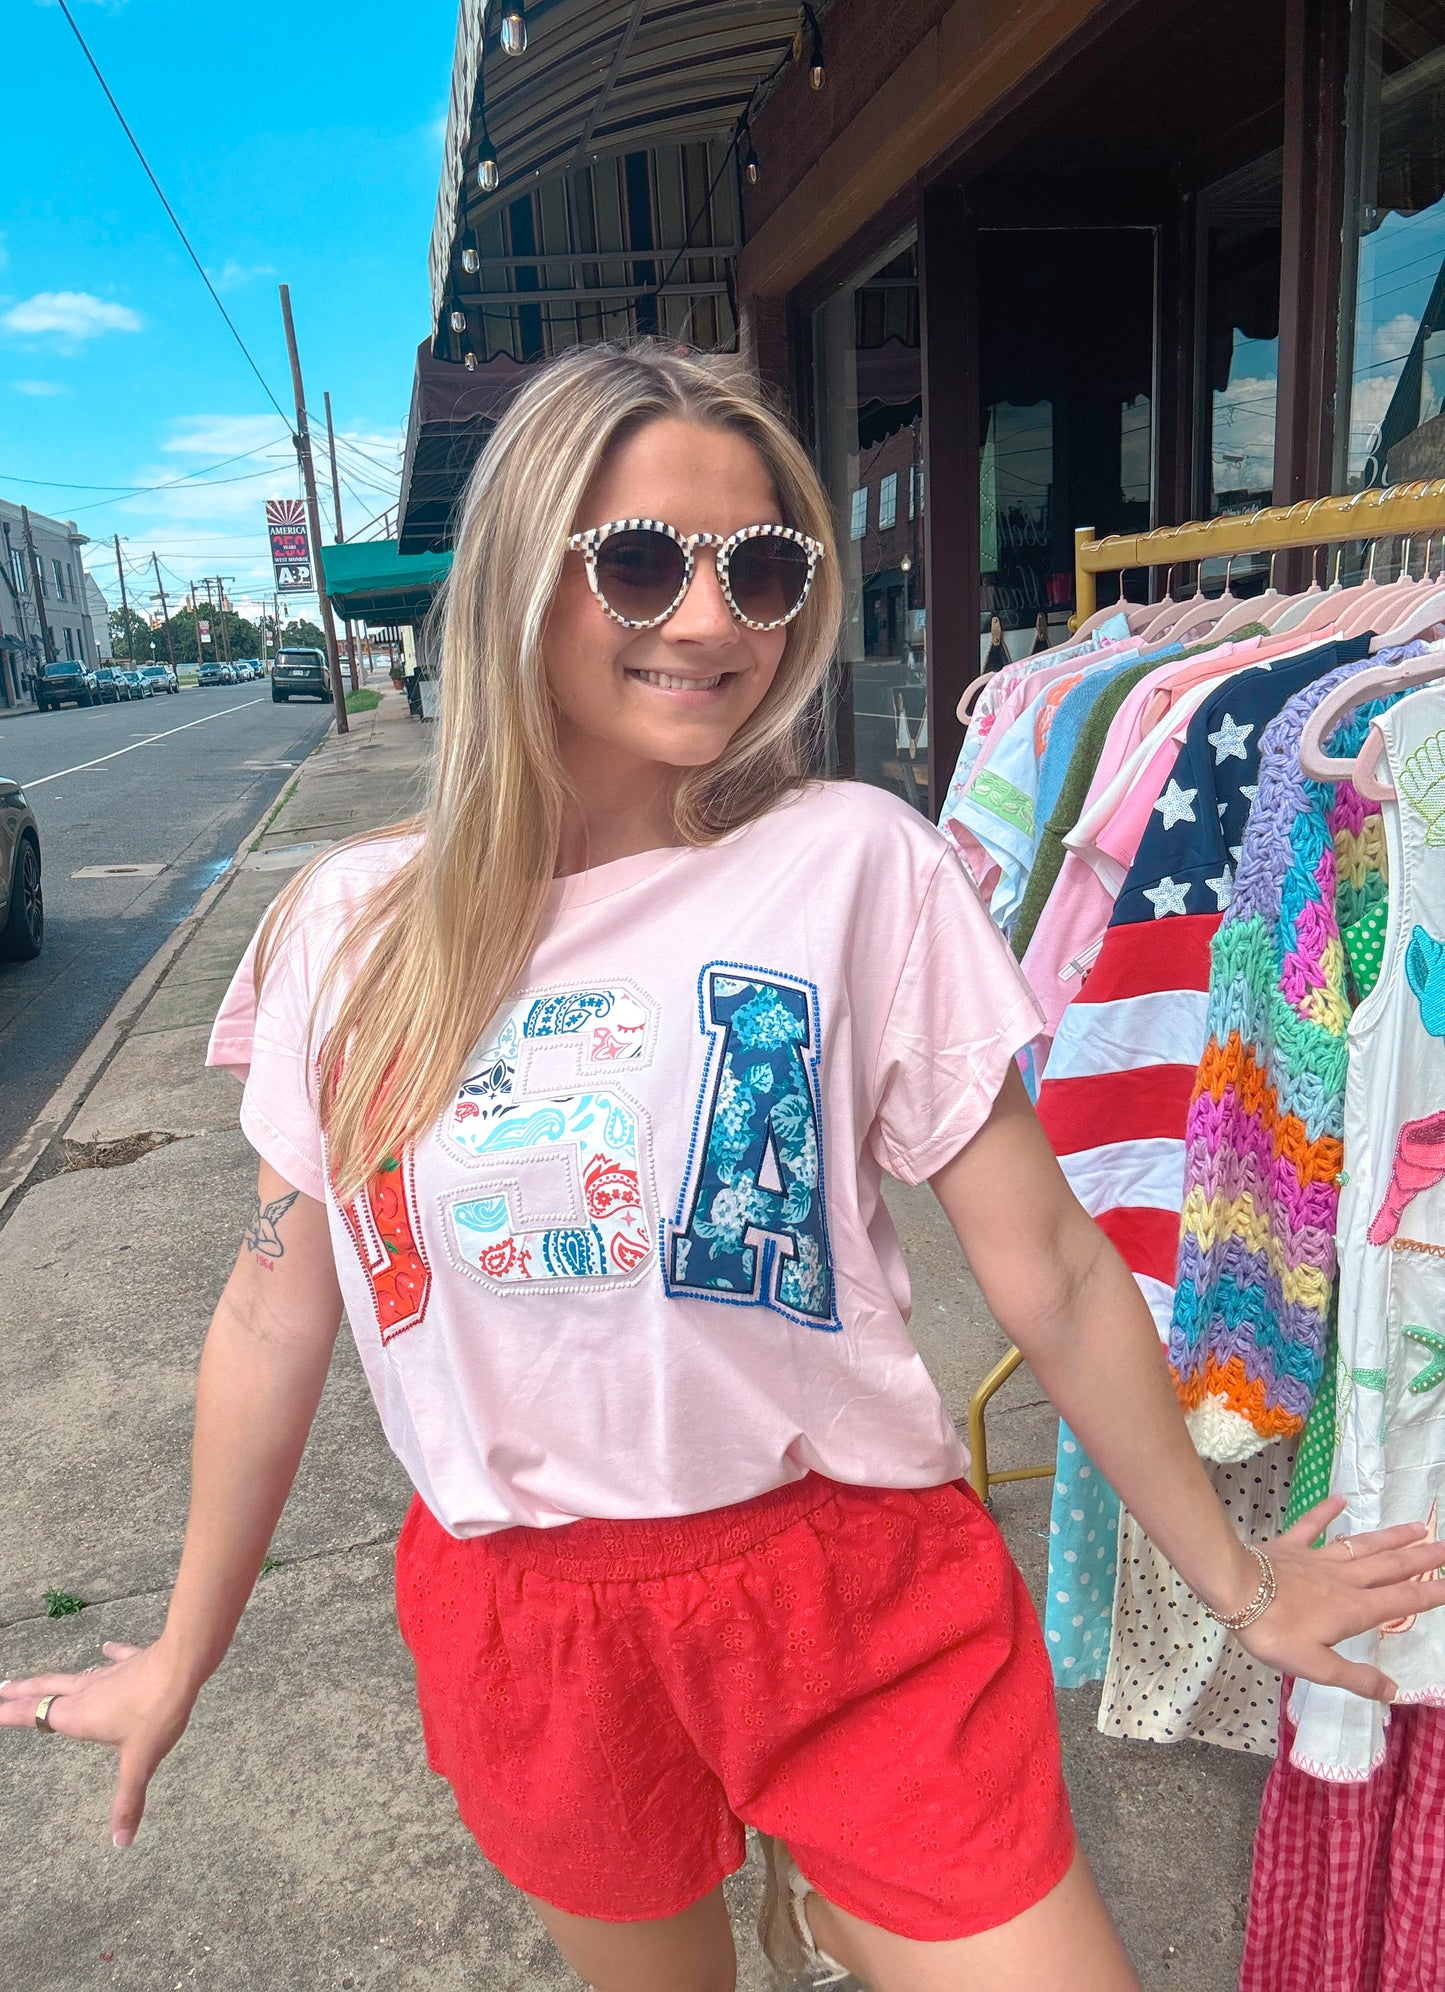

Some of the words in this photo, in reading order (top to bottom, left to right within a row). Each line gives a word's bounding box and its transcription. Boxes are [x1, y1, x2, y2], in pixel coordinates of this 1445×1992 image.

[270, 526, 306, 535] AMERICA
[273, 535, 306, 557] 250
[256, 1253, 275, 1272] 1964
